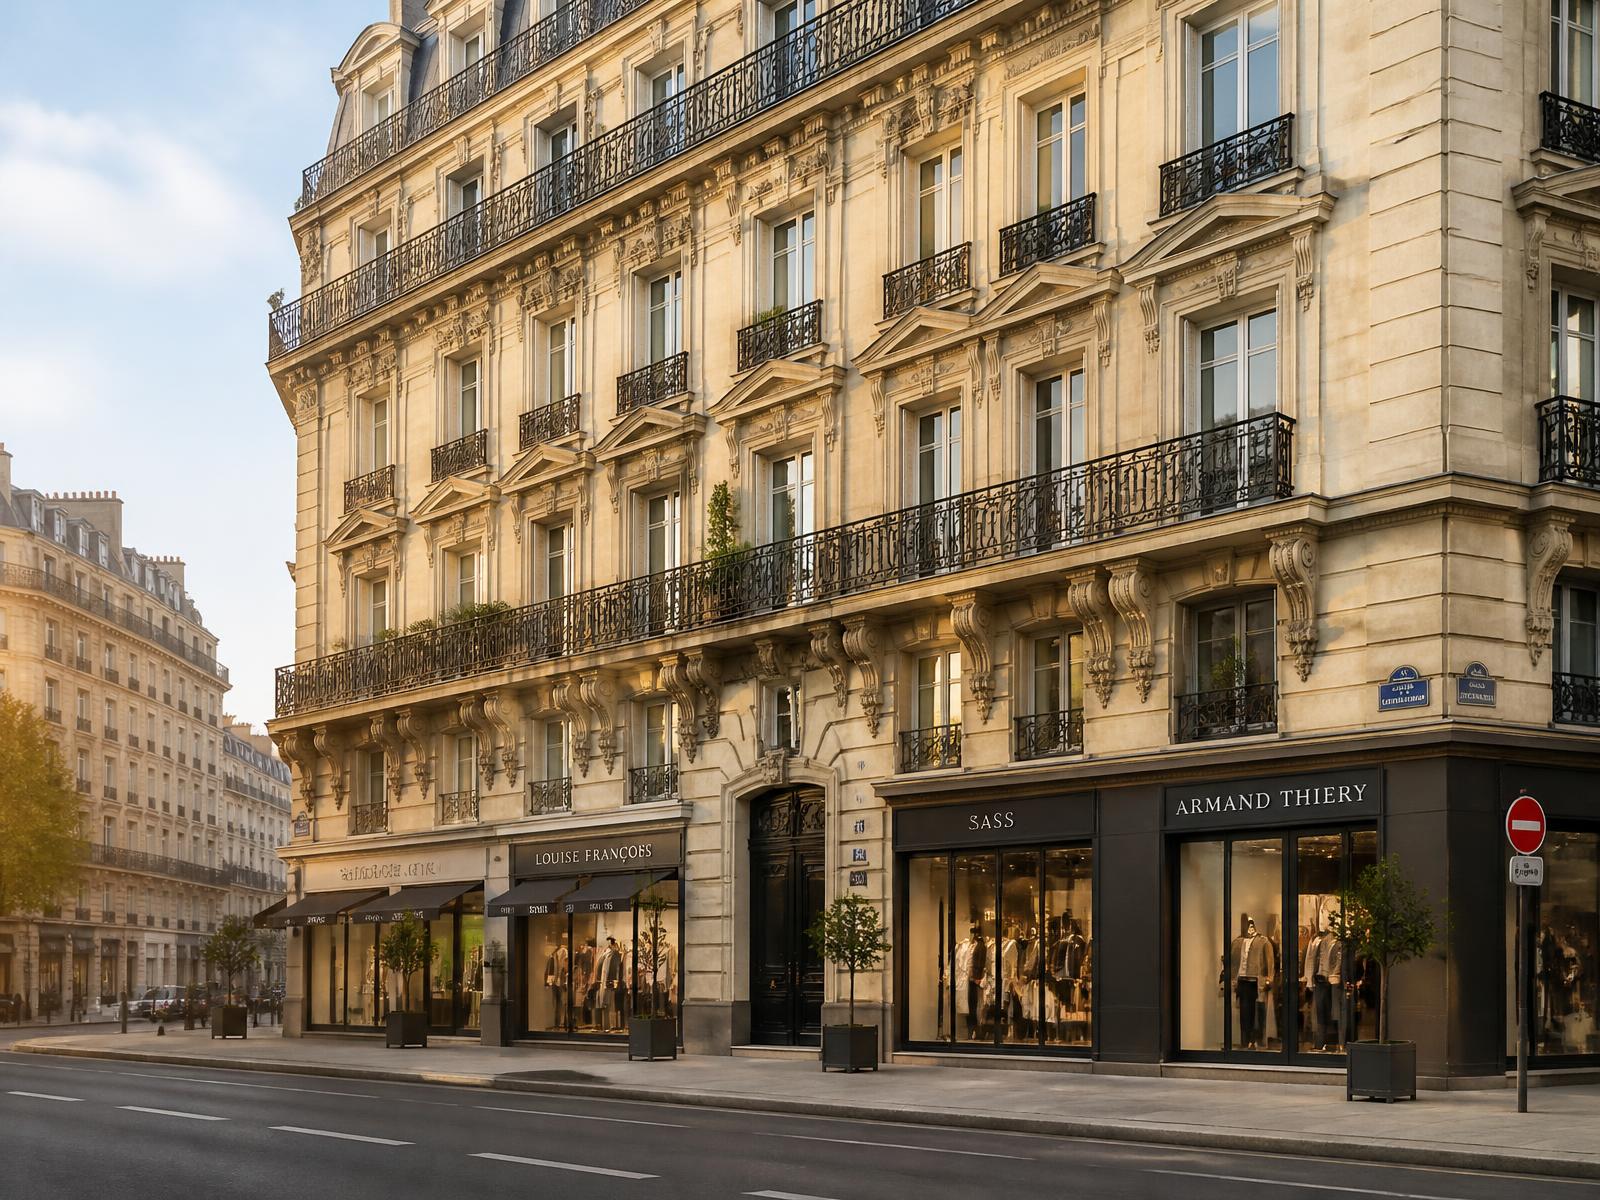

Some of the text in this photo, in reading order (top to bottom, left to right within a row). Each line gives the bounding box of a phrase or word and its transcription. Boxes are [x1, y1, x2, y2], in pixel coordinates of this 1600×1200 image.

[1175, 784, 1367, 815] ARMAND THIERY
[968, 811, 1015, 830] SASS
[535, 850, 580, 866] LOUISE
